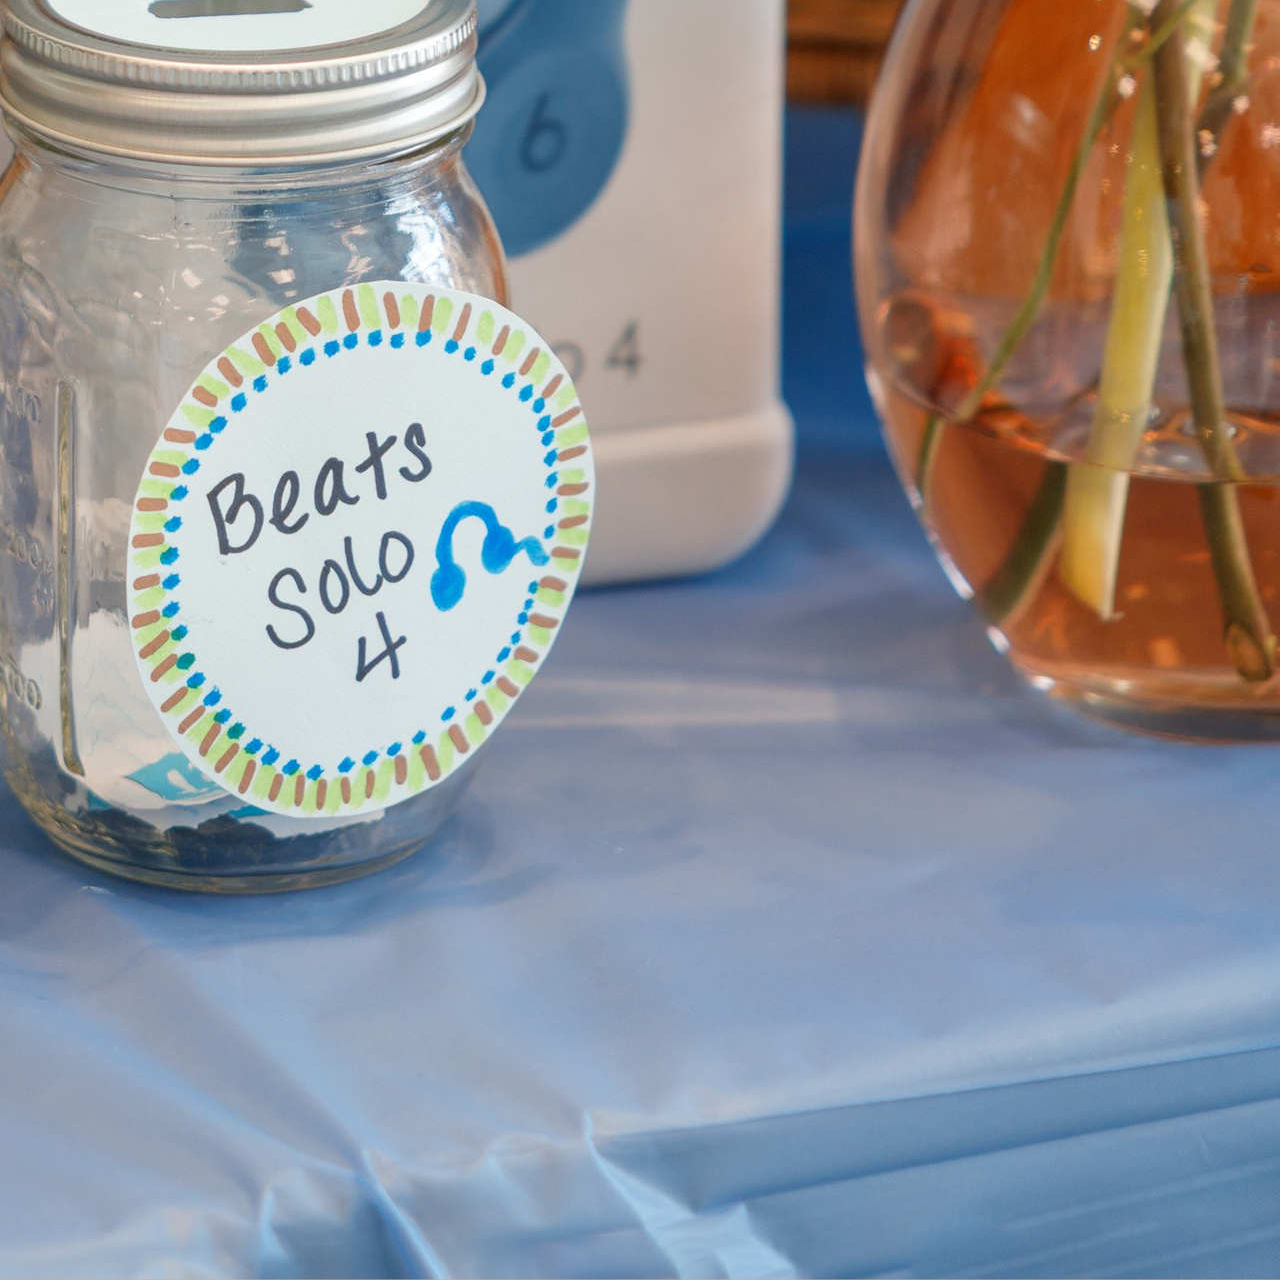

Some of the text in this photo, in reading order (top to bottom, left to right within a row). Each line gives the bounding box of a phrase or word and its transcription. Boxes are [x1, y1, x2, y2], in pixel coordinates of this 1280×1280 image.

[206, 422, 433, 556] Beats
[266, 530, 415, 649] Solo
[355, 612, 407, 682] 4
